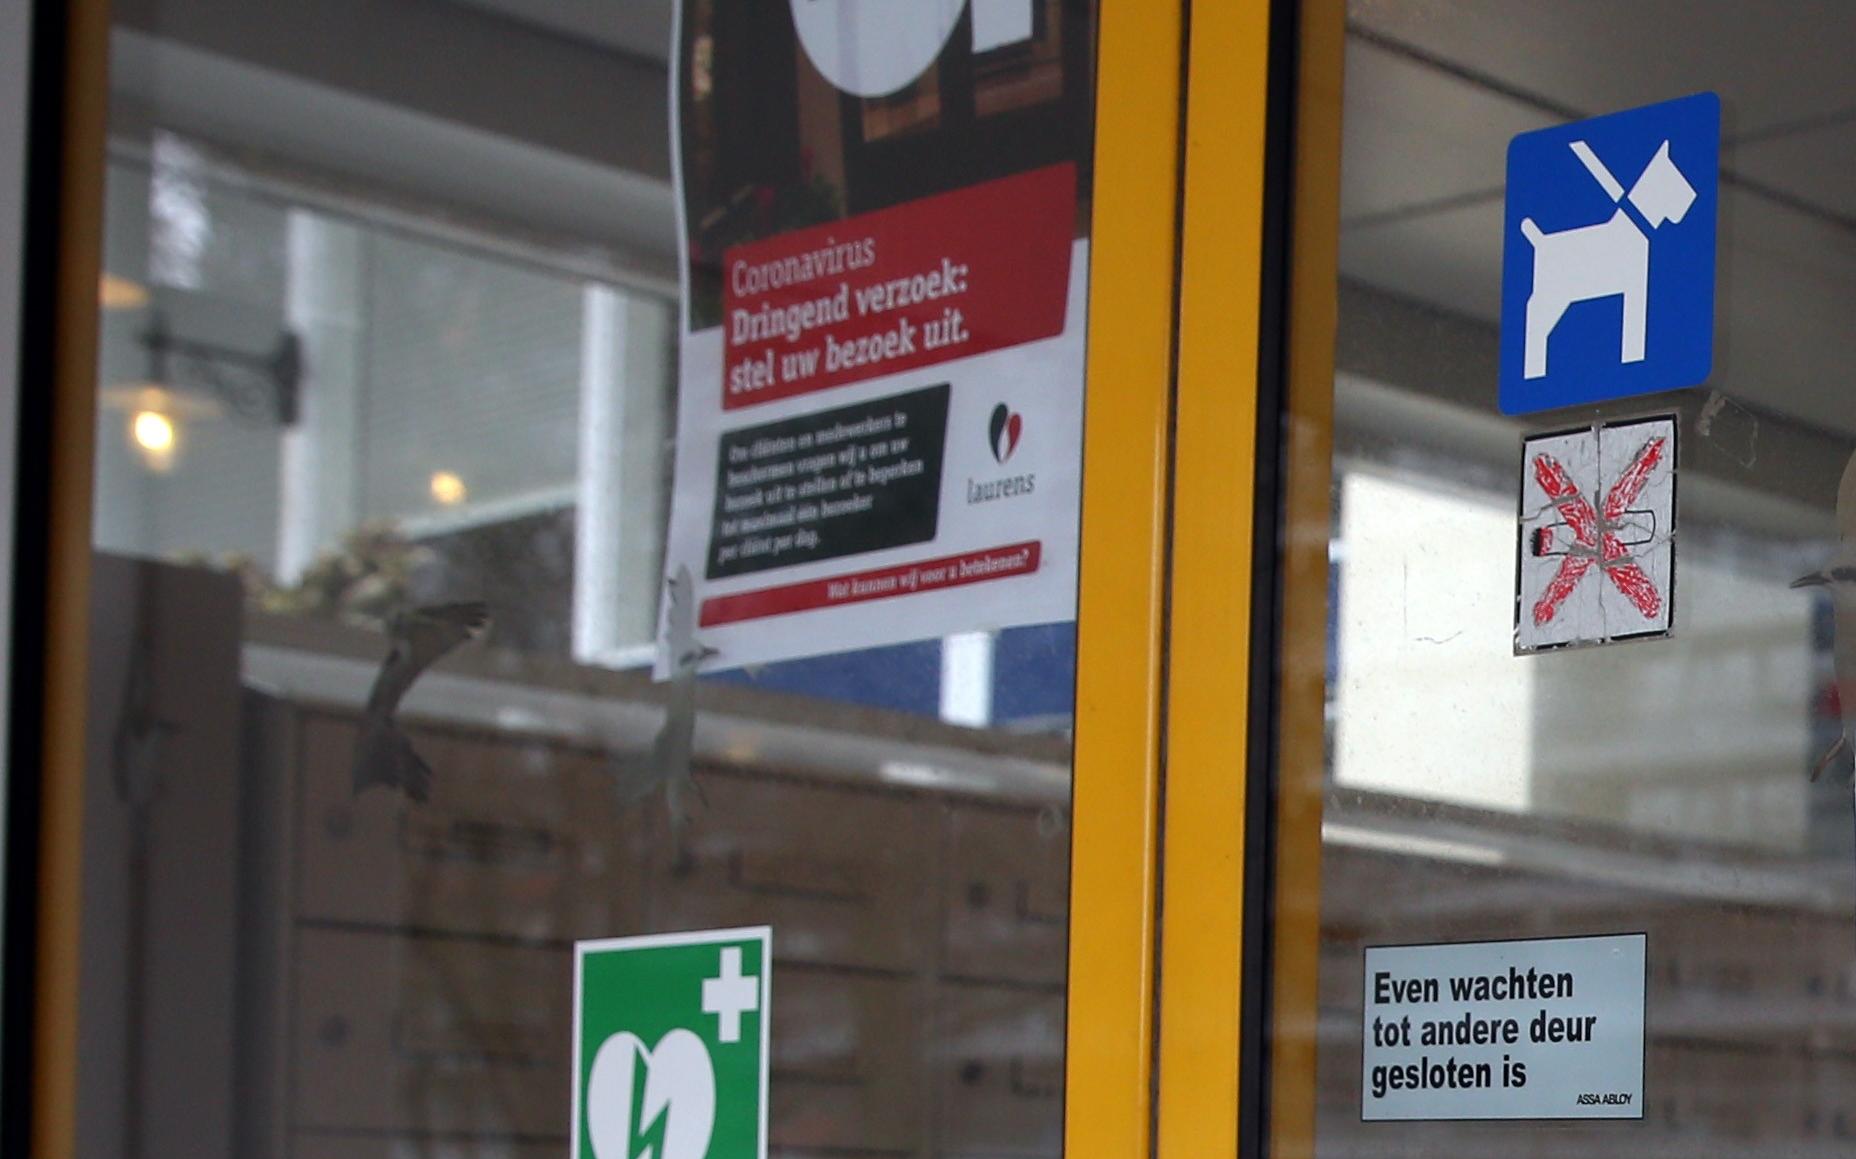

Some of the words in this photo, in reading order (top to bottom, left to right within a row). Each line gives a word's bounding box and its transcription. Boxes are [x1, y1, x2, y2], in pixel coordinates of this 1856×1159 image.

[732, 237, 875, 297] Coronavirus
[731, 283, 849, 346] Dringend
[856, 257, 968, 316] verzoek:
[730, 352, 775, 394] stel
[782, 348, 819, 382] uw
[825, 318, 916, 372] bezoek
[923, 309, 969, 349] uit.
[967, 473, 1035, 504] laurens
[1374, 972, 1438, 1004] Even
[1450, 967, 1573, 1002] wachten
[1373, 1015, 1411, 1047] tot
[1421, 1012, 1519, 1046] andere
[1530, 1009, 1596, 1043] deur
[1372, 1057, 1491, 1098] gesloten
[1503, 1054, 1526, 1088] is
[1577, 1094, 1600, 1105] ASSA
[1602, 1094, 1632, 1105] ABLOY
